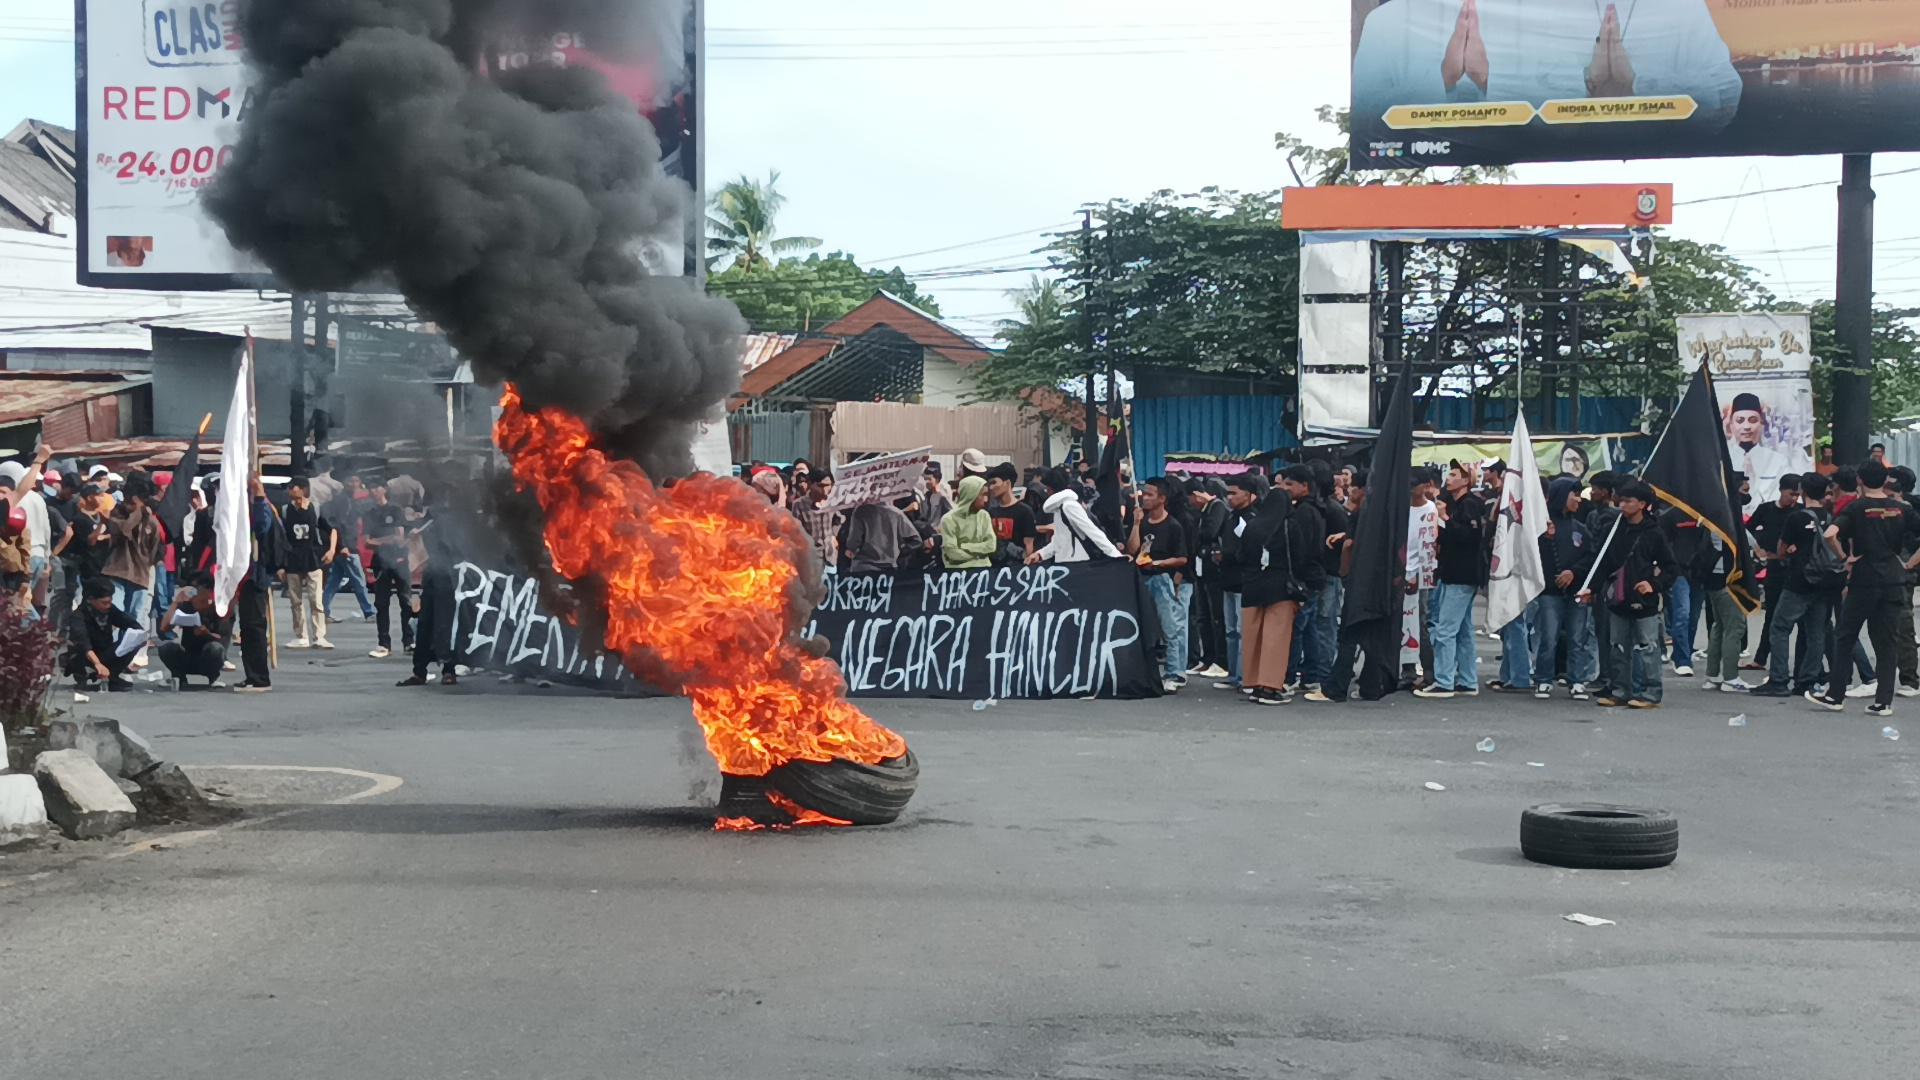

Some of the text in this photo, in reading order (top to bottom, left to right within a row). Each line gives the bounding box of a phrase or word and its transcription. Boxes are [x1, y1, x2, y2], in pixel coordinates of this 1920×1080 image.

[1410, 110, 1449, 119] DANNY
[1451, 107, 1508, 118] POMANTO
[1557, 104, 1597, 114] INDIRA
[1599, 102, 1636, 113] YUSUF
[1638, 101, 1677, 112] ISMAIL
[921, 565, 1072, 612] MAKASSAR
[840, 607, 1140, 698] NEGARA HANCUR
